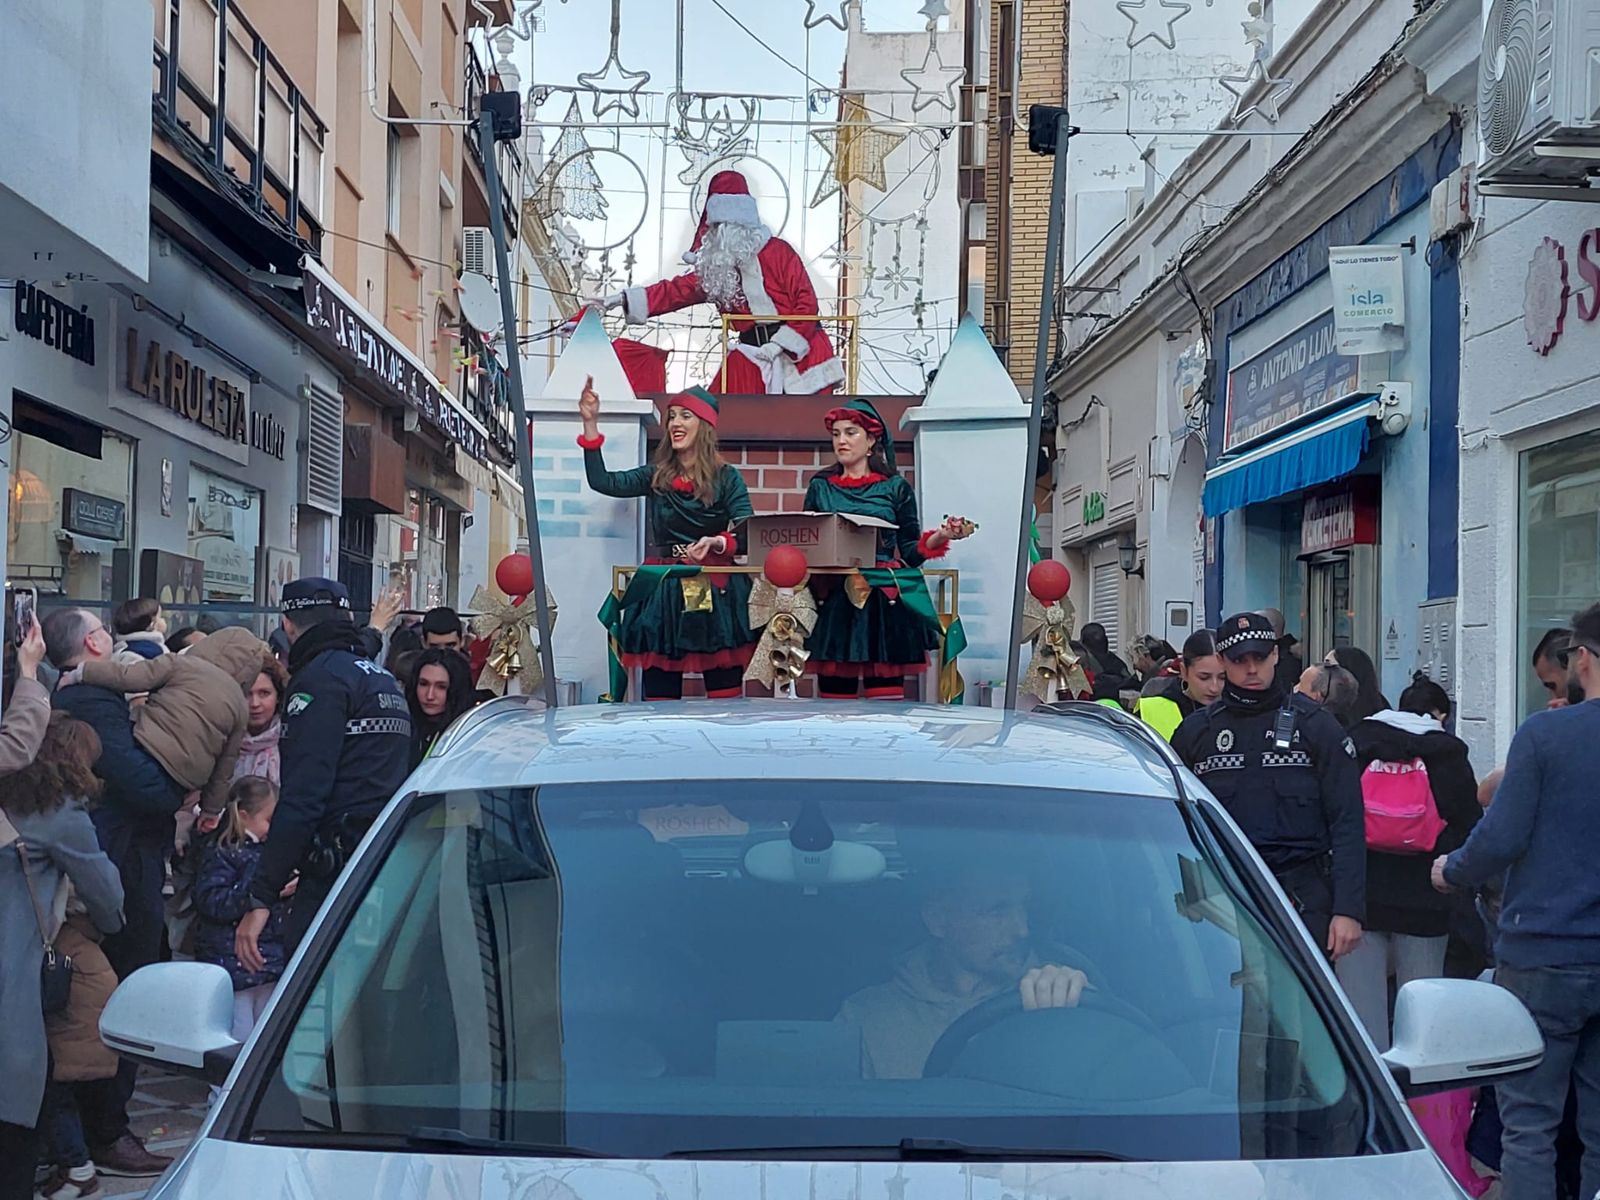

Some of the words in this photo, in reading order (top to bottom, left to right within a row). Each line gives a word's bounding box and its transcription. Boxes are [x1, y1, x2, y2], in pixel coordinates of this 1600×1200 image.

[1352, 287, 1384, 305] isla
[1344, 307, 1393, 317] COMERCIO
[1260, 339, 1306, 390] ANTONIO
[760, 526, 820, 547] ROSHEN
[655, 815, 732, 831] ROSHEN
